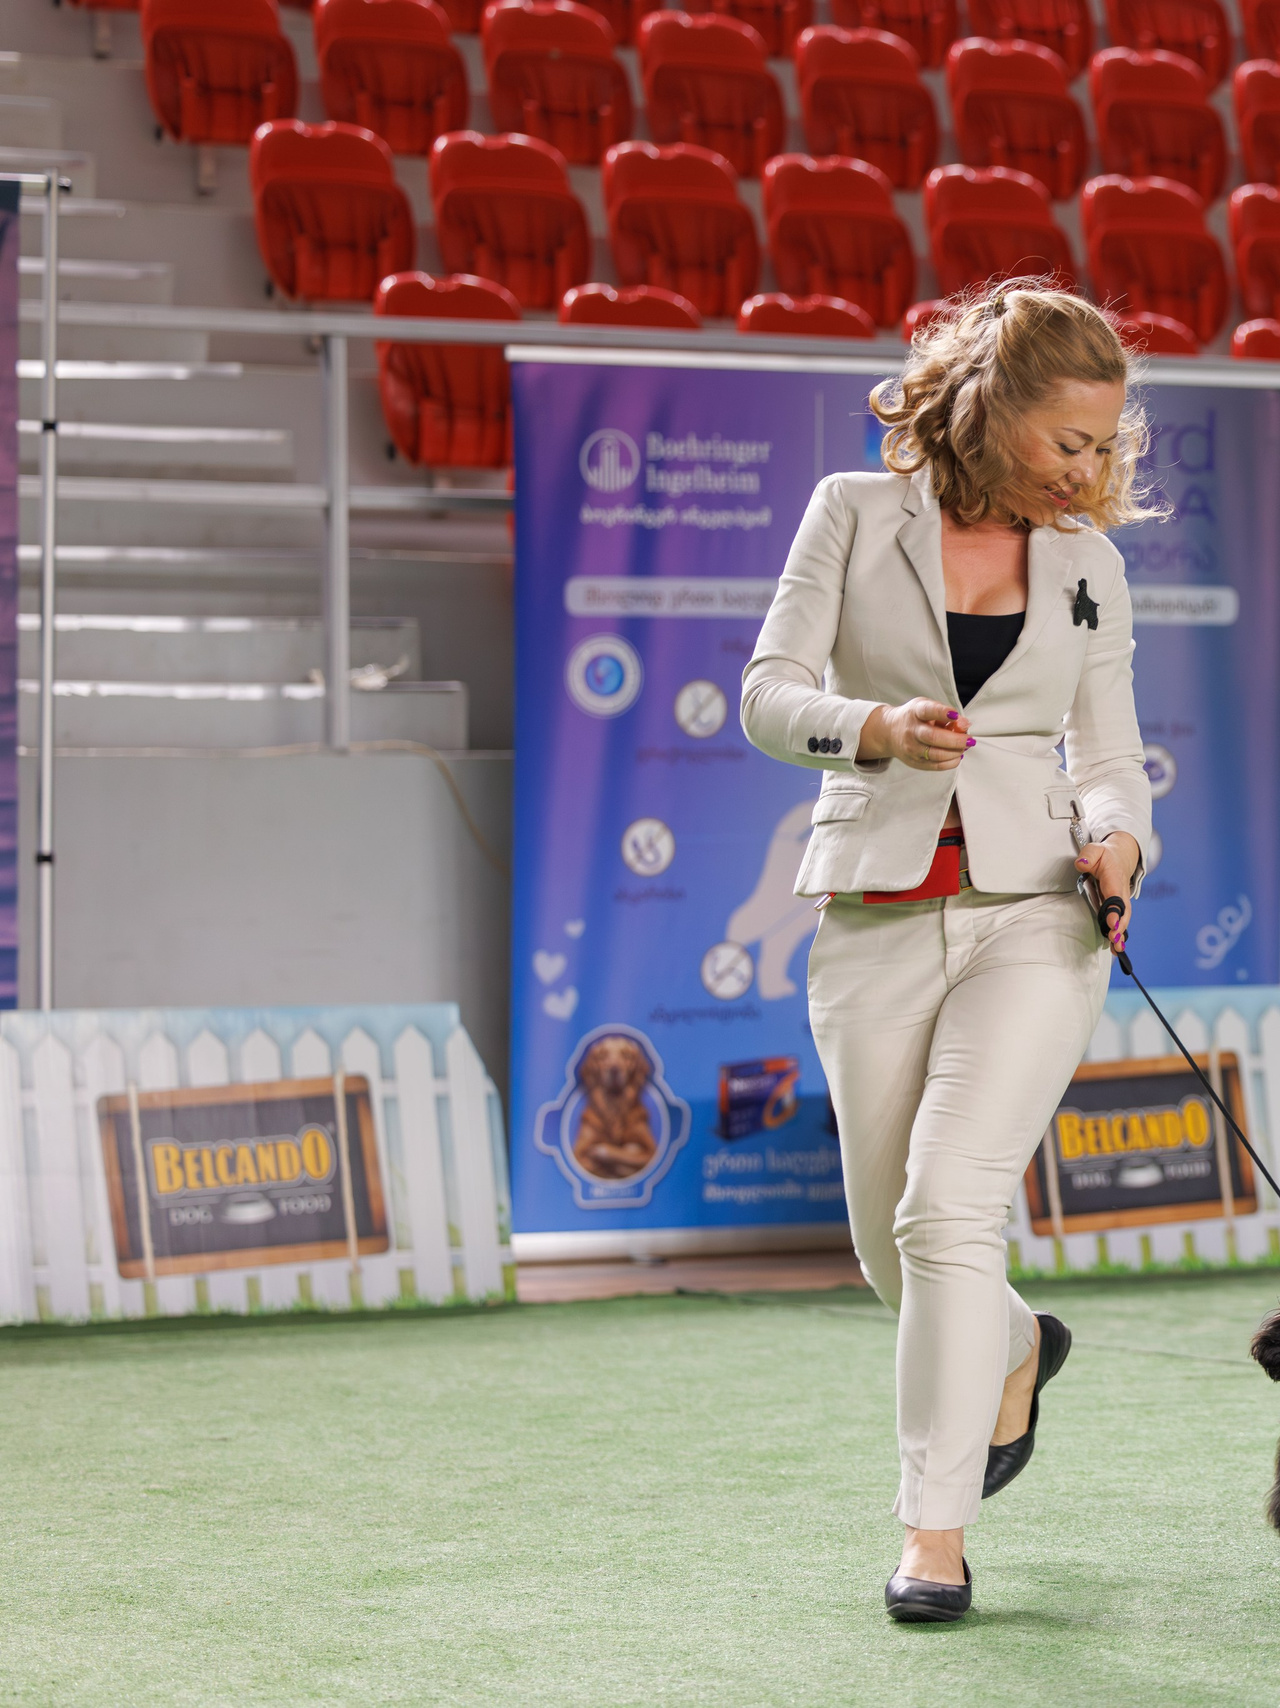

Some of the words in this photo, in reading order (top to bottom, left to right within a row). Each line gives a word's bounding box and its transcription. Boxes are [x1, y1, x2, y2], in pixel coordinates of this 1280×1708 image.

[647, 433, 771, 465] Boehringer
[647, 465, 759, 496] Ingelheim
[1058, 1101, 1209, 1159] BELCANDO
[152, 1129, 331, 1194] BELCANDO
[170, 1206, 212, 1226] DOG
[280, 1195, 331, 1215] FOOD
